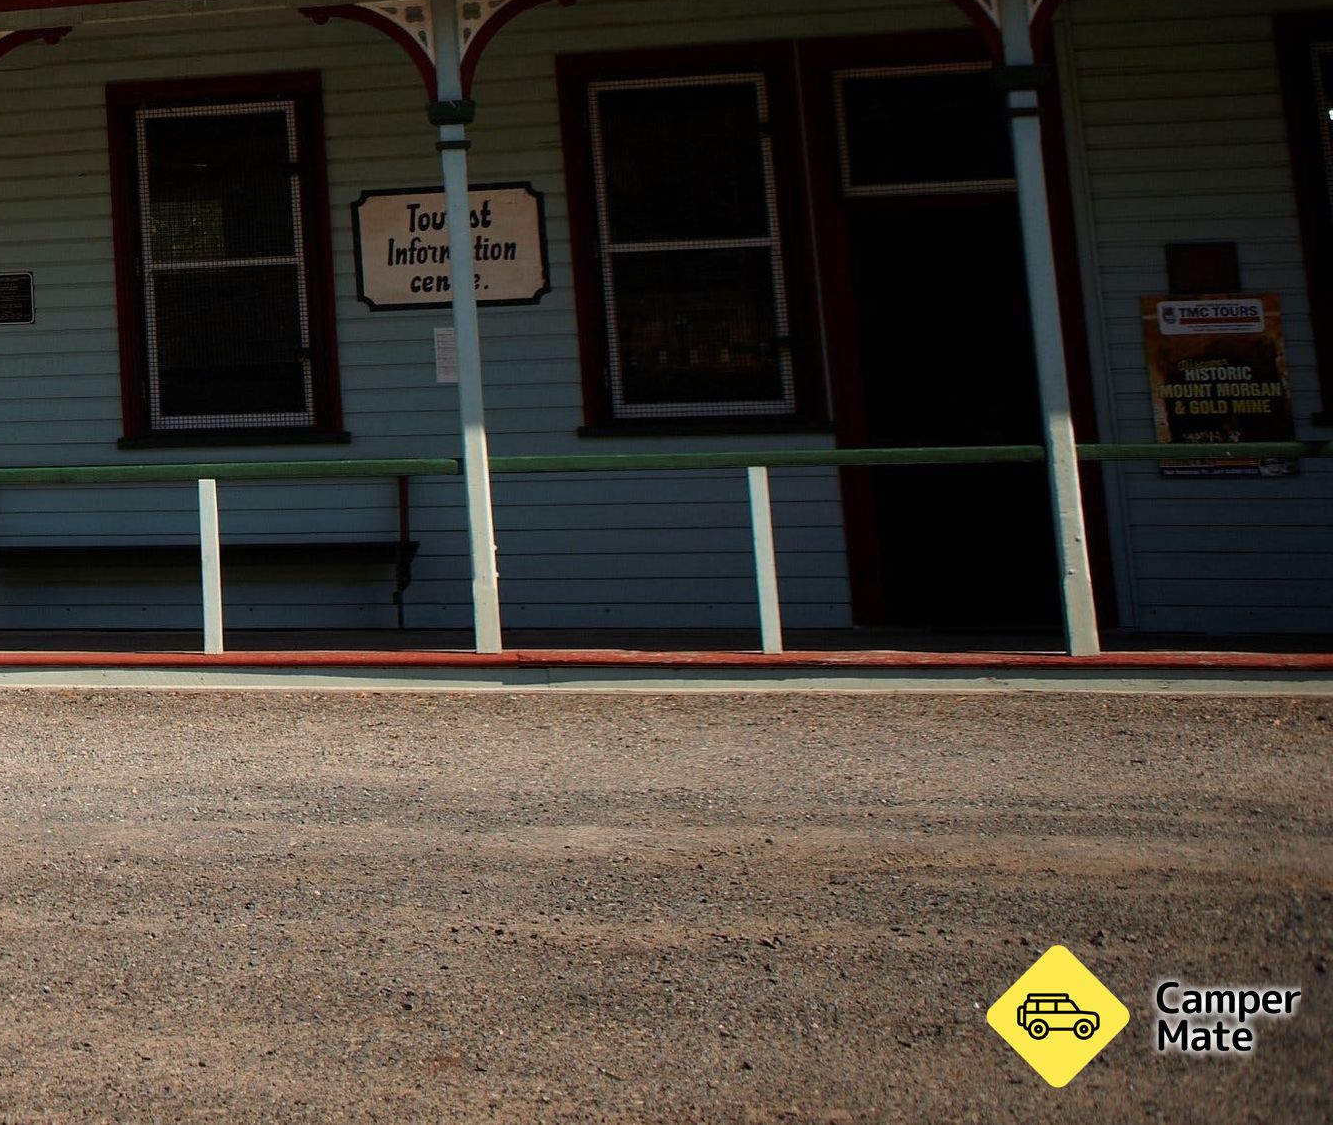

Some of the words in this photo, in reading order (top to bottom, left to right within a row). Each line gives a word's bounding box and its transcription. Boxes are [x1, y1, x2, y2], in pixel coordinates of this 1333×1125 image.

[1178, 306, 1209, 318] TMC
[1211, 305, 1258, 317] TOURS
[1185, 366, 1253, 381] HISTORIC
[1159, 384, 1212, 399] MOUNT
[1217, 382, 1282, 397] MORGAN
[1174, 401, 1185, 415] &
[1189, 401, 1228, 415] GOLD
[1232, 399, 1271, 414] MINE
